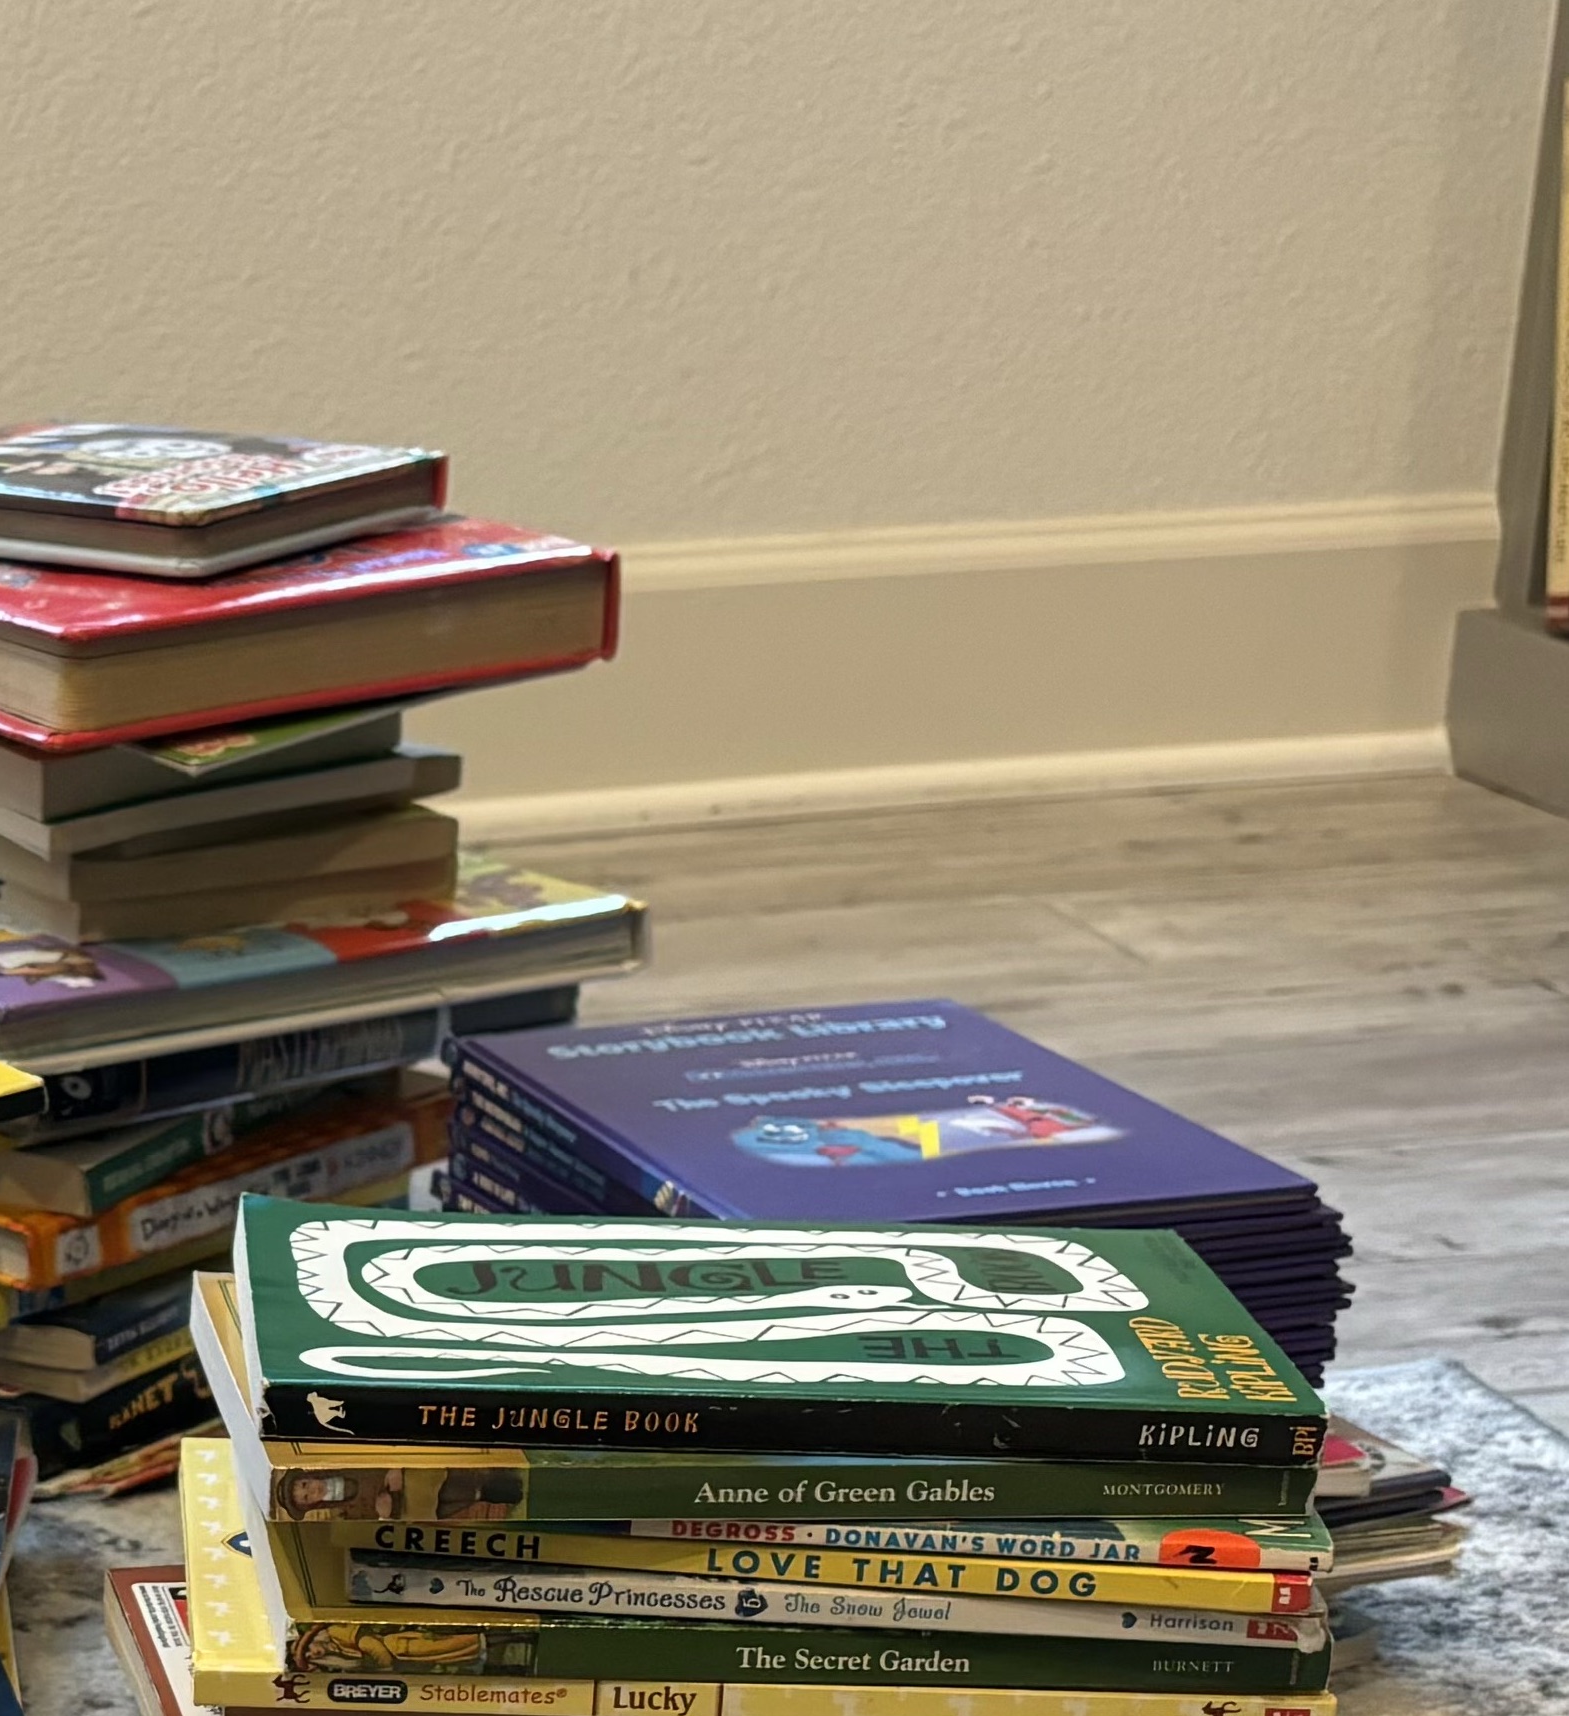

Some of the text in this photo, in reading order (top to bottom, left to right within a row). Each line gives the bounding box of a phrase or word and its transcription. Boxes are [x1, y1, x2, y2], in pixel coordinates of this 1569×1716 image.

[418, 1405, 700, 1434] THE JUNGLE BOOK
[694, 1479, 995, 1505] Anne of Green Gables
[1102, 1481, 1224, 1498] MONTGOMERY
[671, 1519, 1141, 1563] DEGROSS DONAVAN'S WORD JAR
[374, 1524, 1099, 1598] CREECH LOVE THAT DOG
[1148, 1613, 1235, 1633] Harrison
[736, 1646, 971, 1675] The Secret Garden
[1152, 1658, 1235, 1674] BURNETT
[331, 1683, 404, 1702] BREYER
[611, 1684, 698, 1716] Lucky
